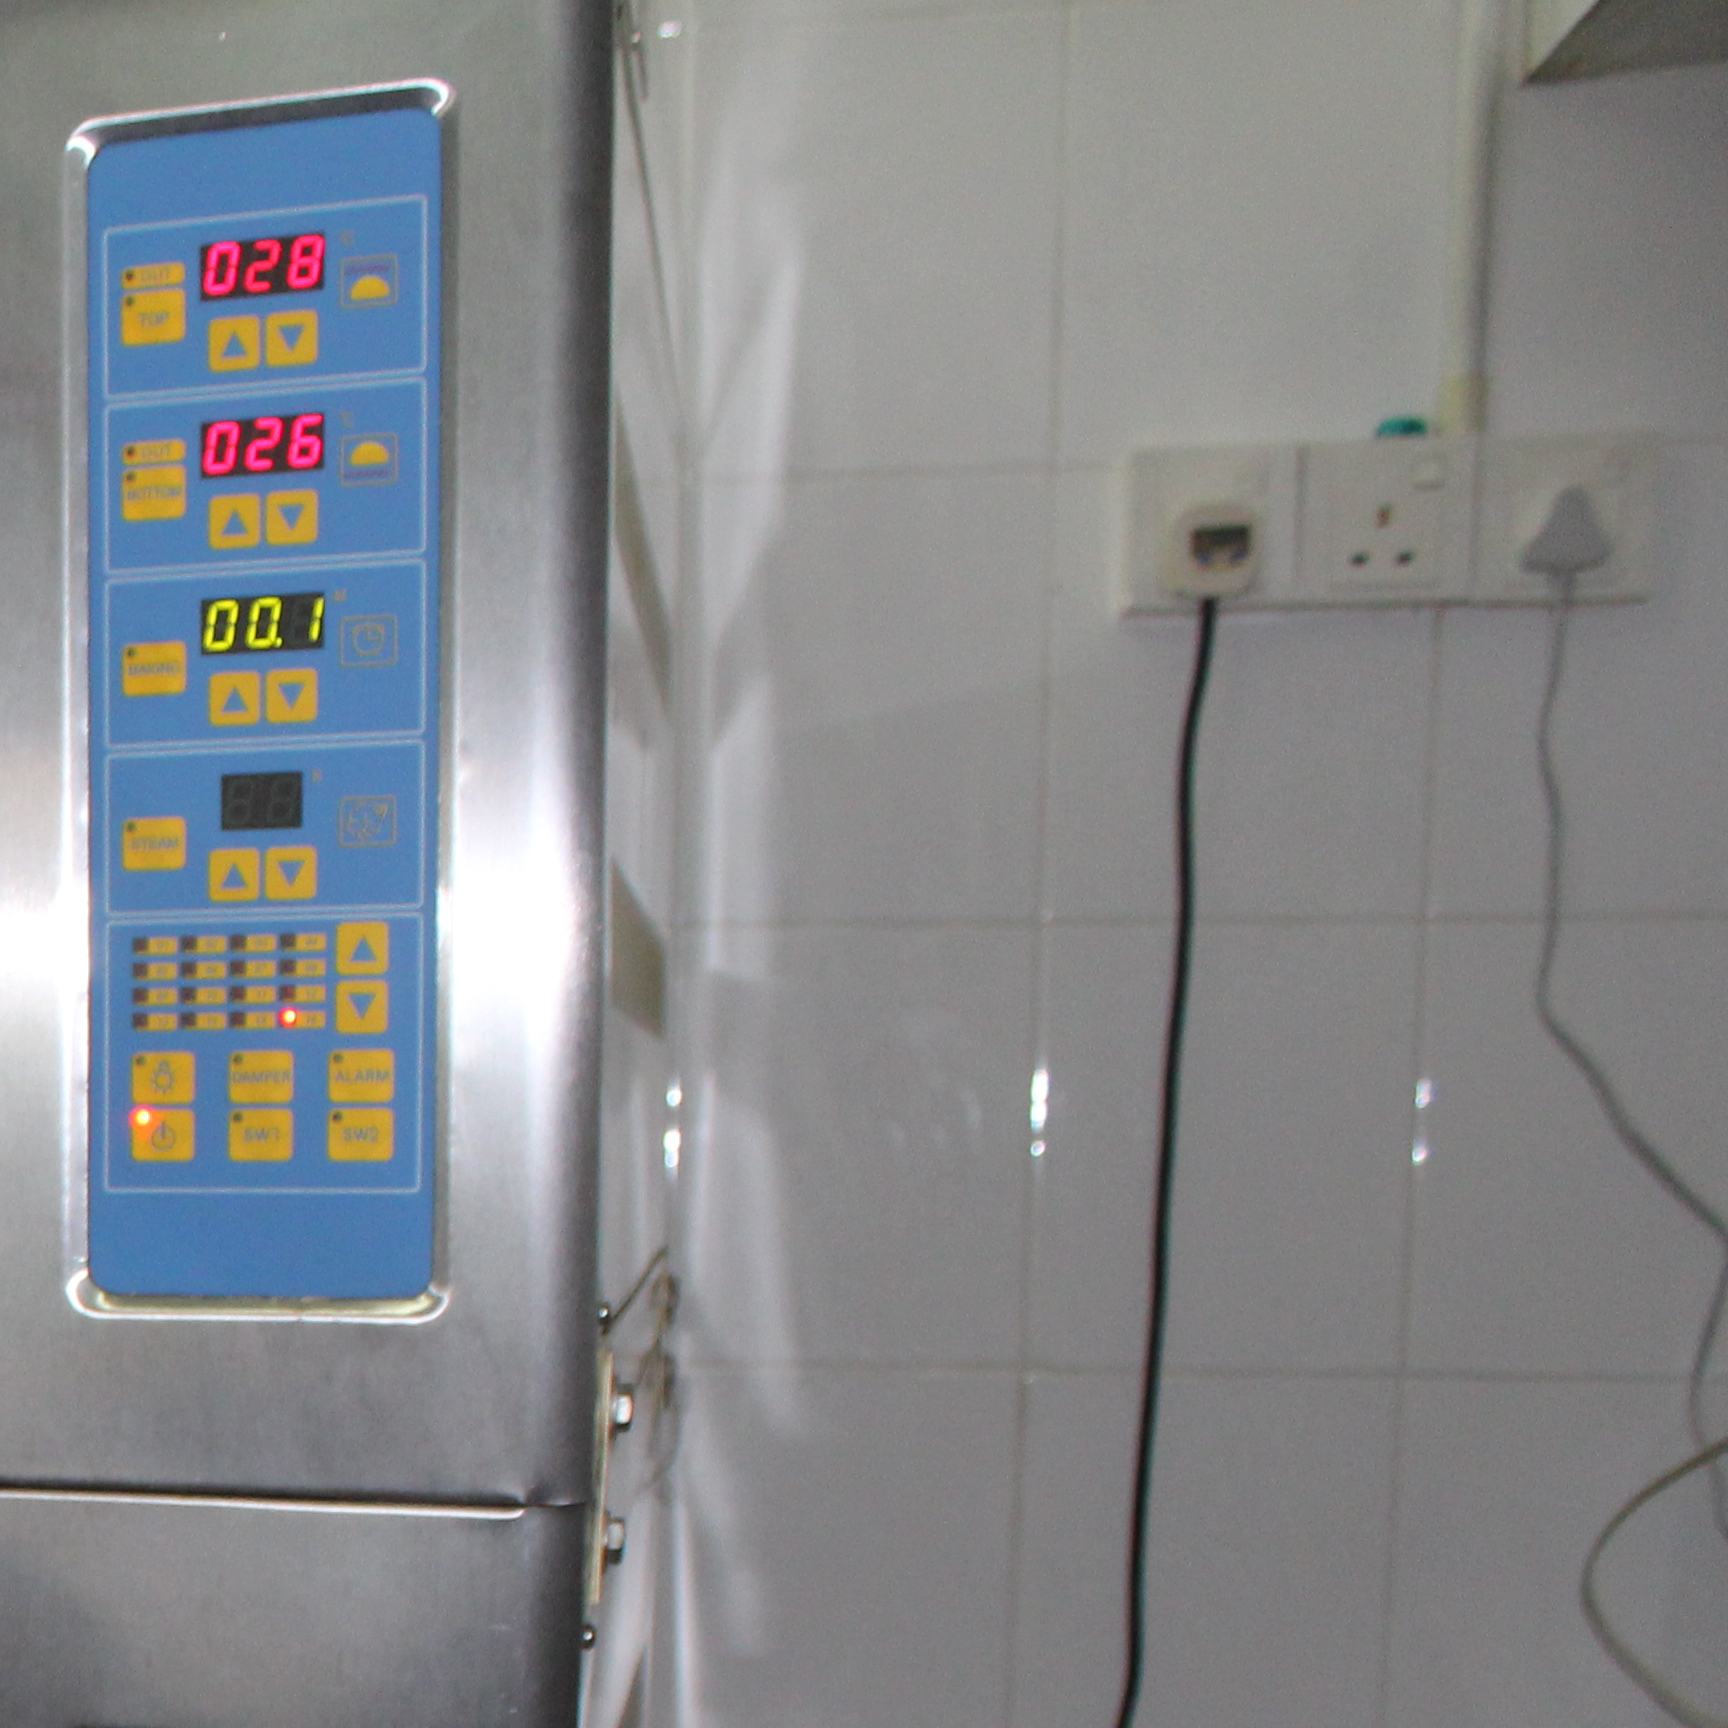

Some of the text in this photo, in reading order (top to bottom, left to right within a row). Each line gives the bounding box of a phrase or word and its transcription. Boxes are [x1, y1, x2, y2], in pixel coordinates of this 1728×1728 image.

[202, 233, 327, 297] 028
[201, 413, 324, 476] 026
[204, 597, 324, 651] 00.1
[232, 1068, 292, 1085] DAMPER
[334, 1067, 390, 1084] ALARM
[243, 1127, 280, 1144] SW1
[341, 1126, 379, 1144] SW2
